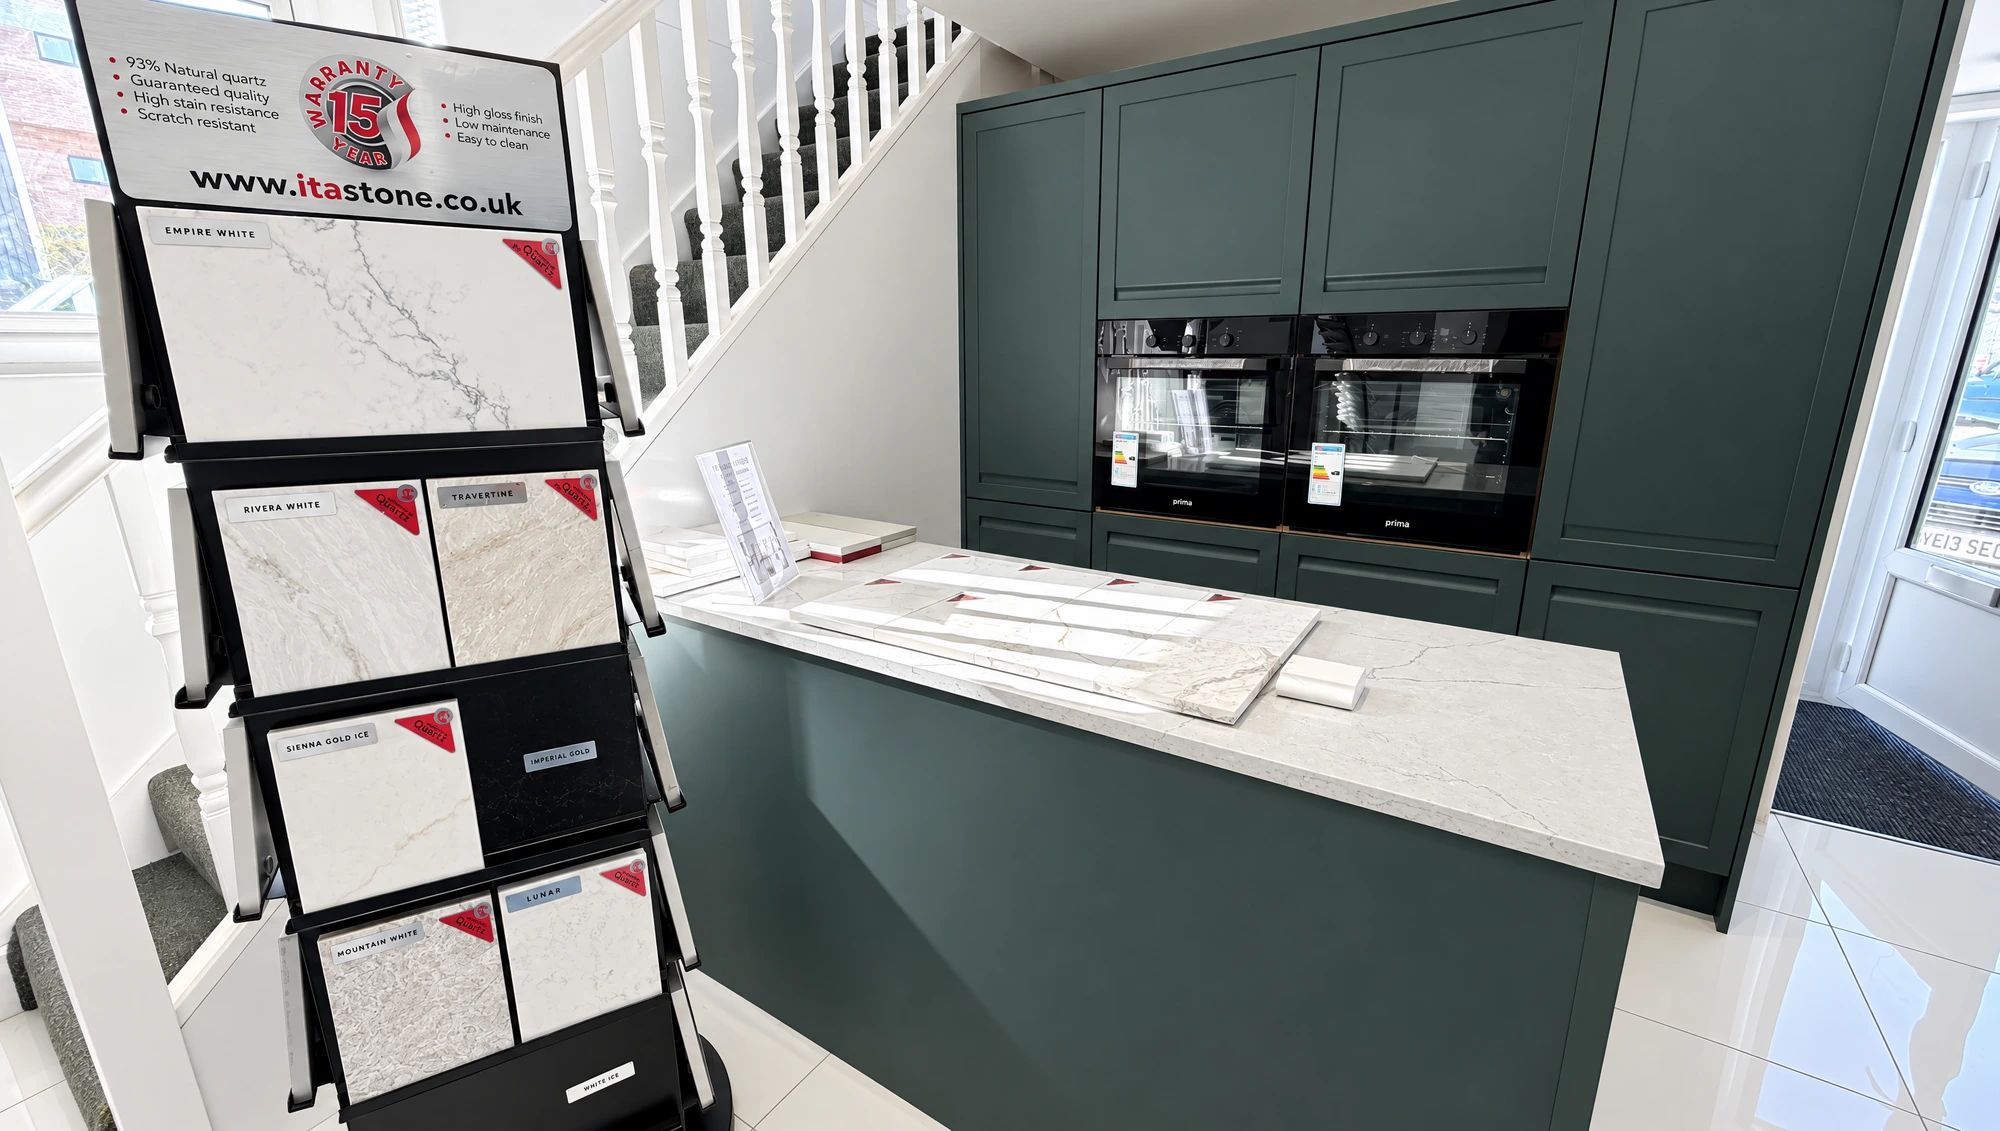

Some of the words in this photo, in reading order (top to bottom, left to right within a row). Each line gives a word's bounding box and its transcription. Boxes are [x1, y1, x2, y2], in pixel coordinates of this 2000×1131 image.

[126, 56, 161, 72] 93%
[164, 62, 218, 80] Natural
[222, 73, 267, 87] quartz
[130, 74, 220, 97] Guaranteed
[223, 87, 270, 106] quality
[305, 60, 404, 129] WARRANTY
[134, 90, 170, 108] High
[173, 97, 207, 111] stain
[211, 104, 280, 120] resistance
[328, 90, 382, 139] 15
[453, 102, 481, 118] High
[483, 107, 513, 120] gloss
[514, 110, 543, 125] finish
[138, 107, 194, 126] Scratch
[197, 118, 257, 134] resistant
[455, 117, 479, 130] Low
[482, 123, 551, 140] maintenance
[333, 136, 388, 166] YEAR
[457, 131, 482, 147] Easy
[485, 137, 497, 147] to
[500, 137, 529, 151] clean
[189, 169, 524, 217] www.itastone.co.uk
[165, 226, 212, 238] EMPIRE
[216, 228, 256, 240] WHITE
[523, 244, 555, 279] Quartz
[452, 489, 514, 501] TRAVERTINE
[561, 482, 591, 510] Quartz
[1172, 498, 1193, 507] prima
[243, 504, 283, 514] RIVERA
[286, 501, 321, 511] WHITE
[375, 493, 410, 523] Quartz
[1385, 519, 1410, 529] prima
[286, 740, 322, 753] SIENNA
[325, 734, 351, 745] GOLD
[354, 730, 370, 740] ICE
[414, 719, 447, 743] Quartz
[530, 752, 567, 765] IMPERIAL
[569, 748, 590, 757] GOLD
[526, 887, 561, 902] LUNAR
[455, 916, 486, 935] Quartz
[337, 938, 387, 958] MOUNTAIN
[389, 929, 418, 942] WHITE
[583, 1078, 606, 1091] WHITE
[608, 1072, 620, 1081] ICE
